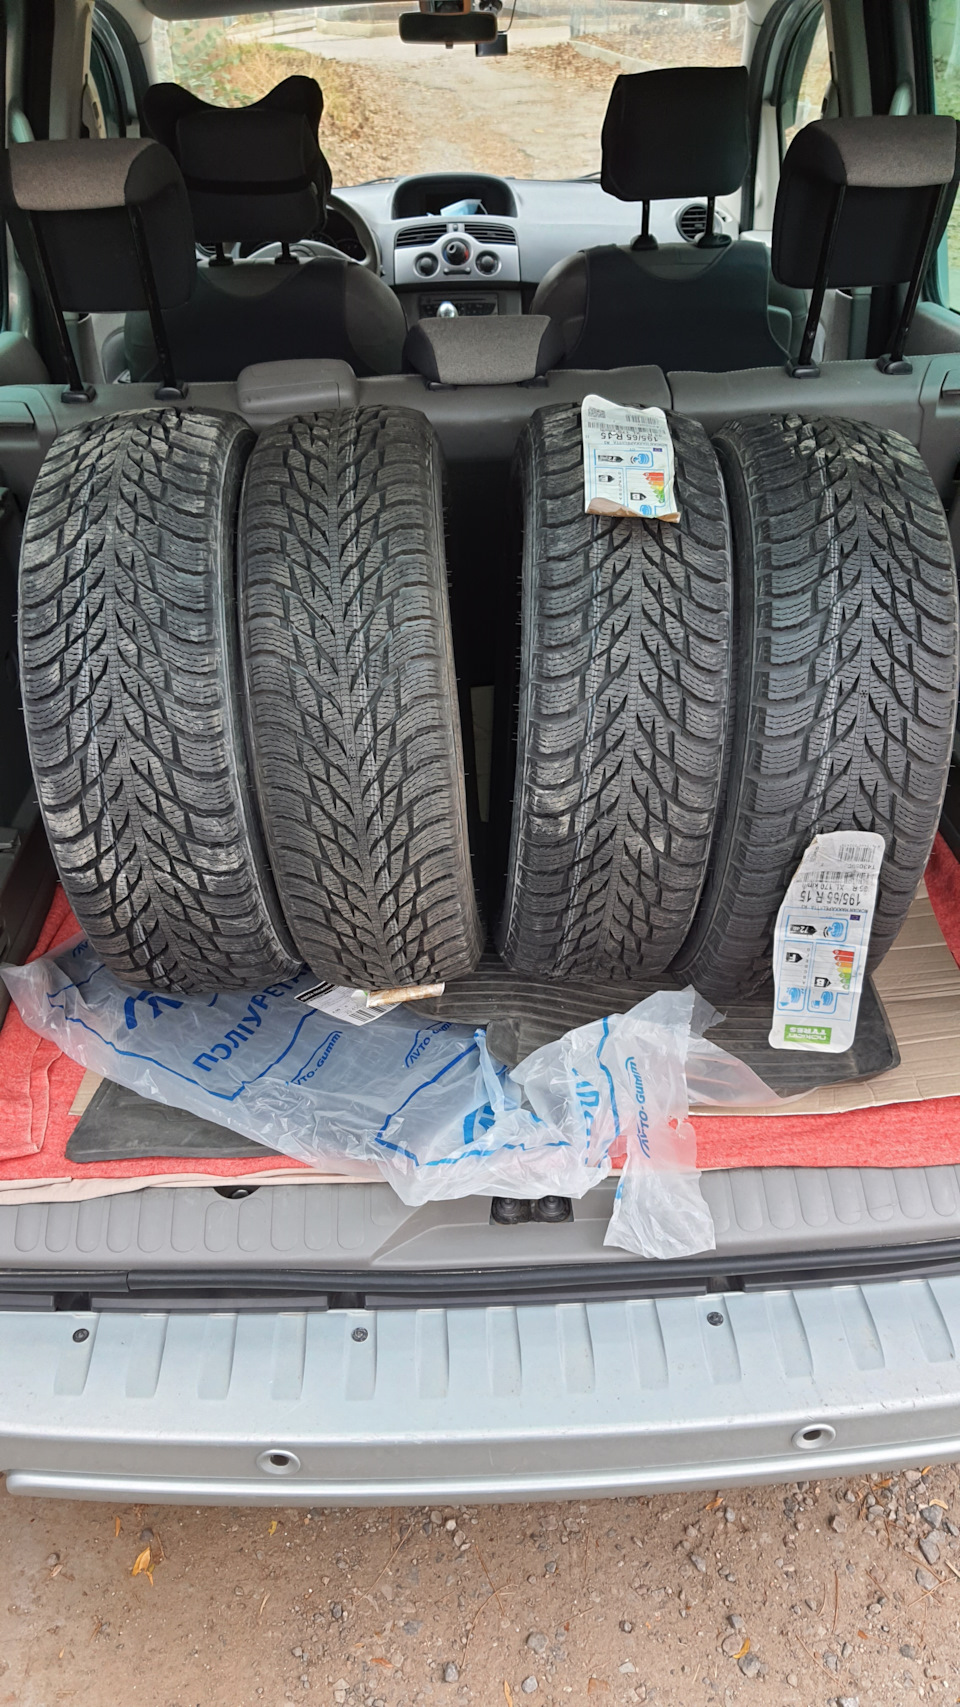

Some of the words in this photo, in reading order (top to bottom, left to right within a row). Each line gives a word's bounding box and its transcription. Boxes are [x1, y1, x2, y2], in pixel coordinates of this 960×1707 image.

[626, 433, 658, 442] 195/65
[799, 890, 811, 903] 15
[816, 891, 824, 903] R
[827, 891, 861, 906] 195/65
